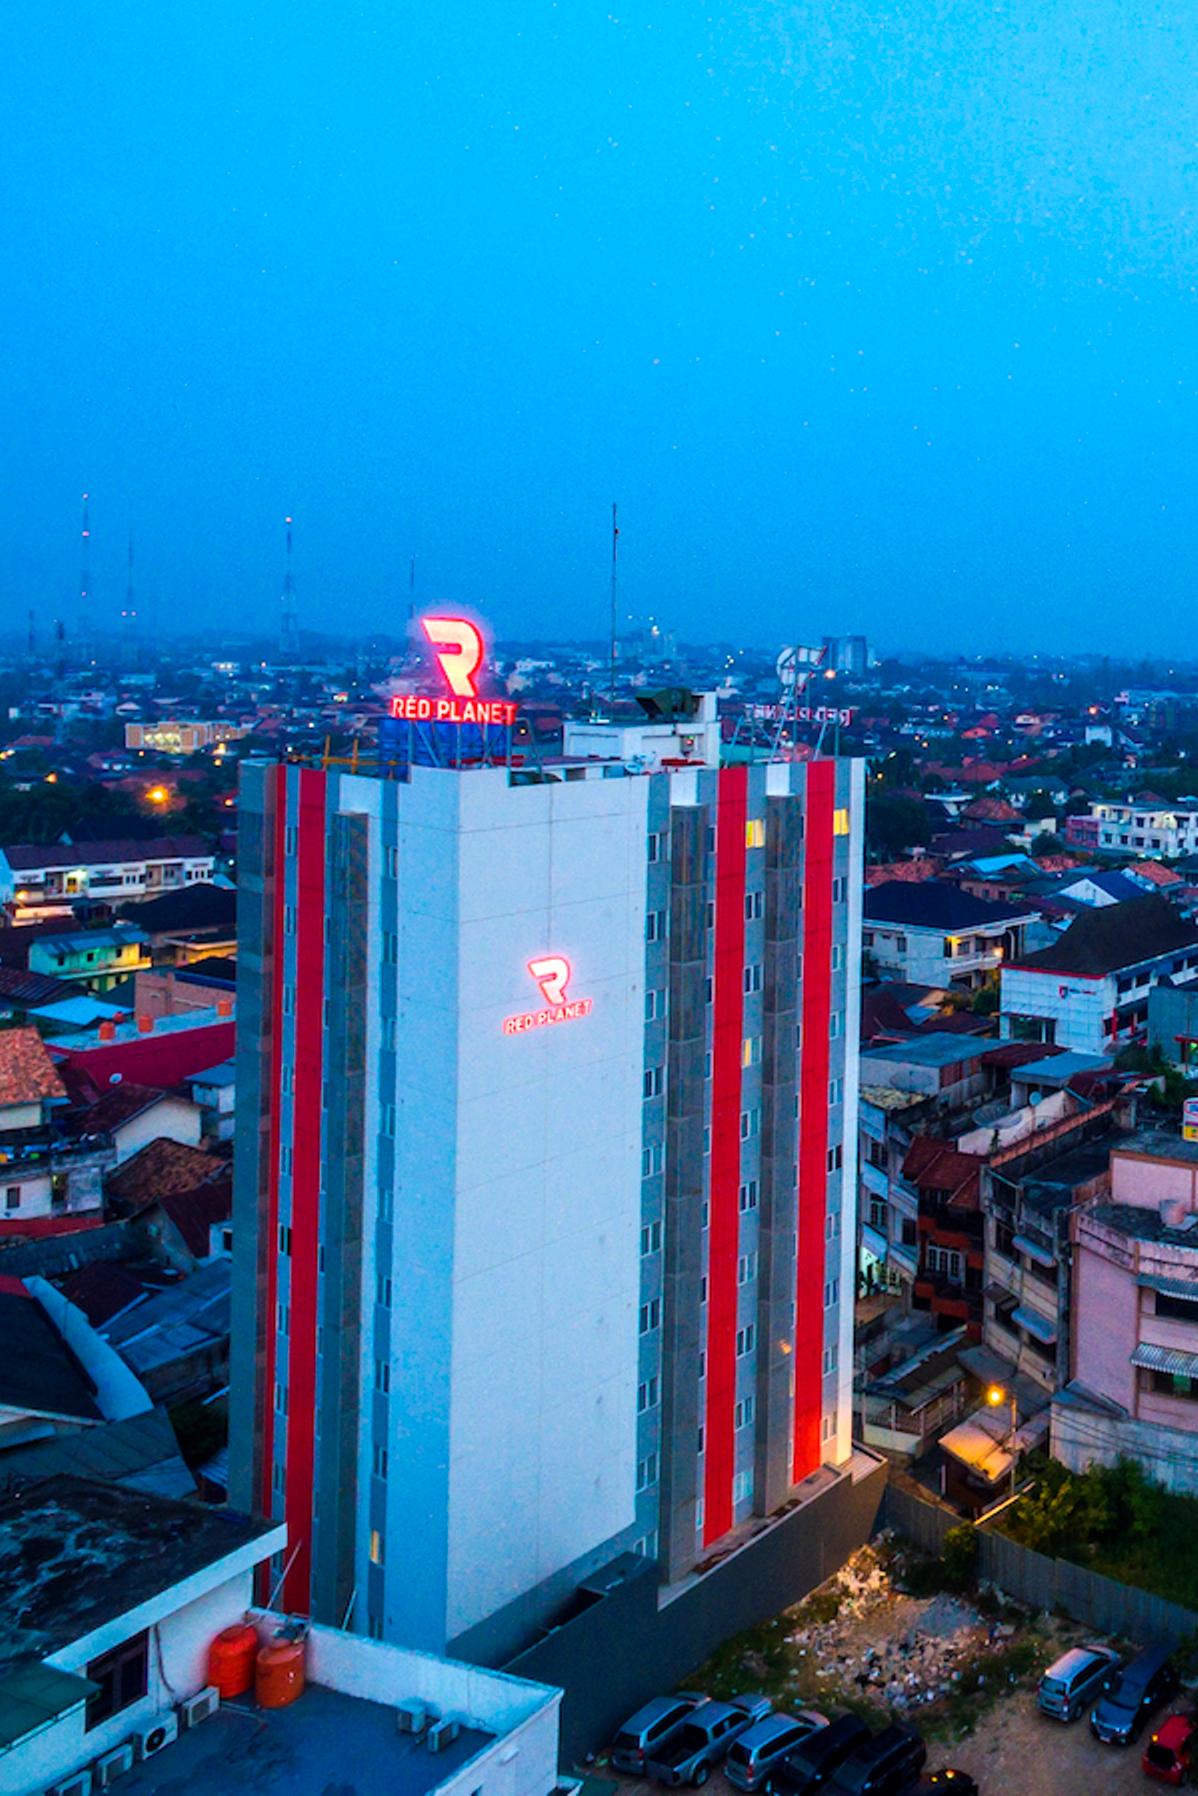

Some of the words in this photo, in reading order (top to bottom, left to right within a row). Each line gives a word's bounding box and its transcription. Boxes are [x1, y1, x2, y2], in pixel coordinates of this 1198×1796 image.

[392, 697, 431, 719] RED
[436, 700, 517, 724] PLANET
[503, 1013, 534, 1035] RED
[536, 999, 593, 1025] PLANET
